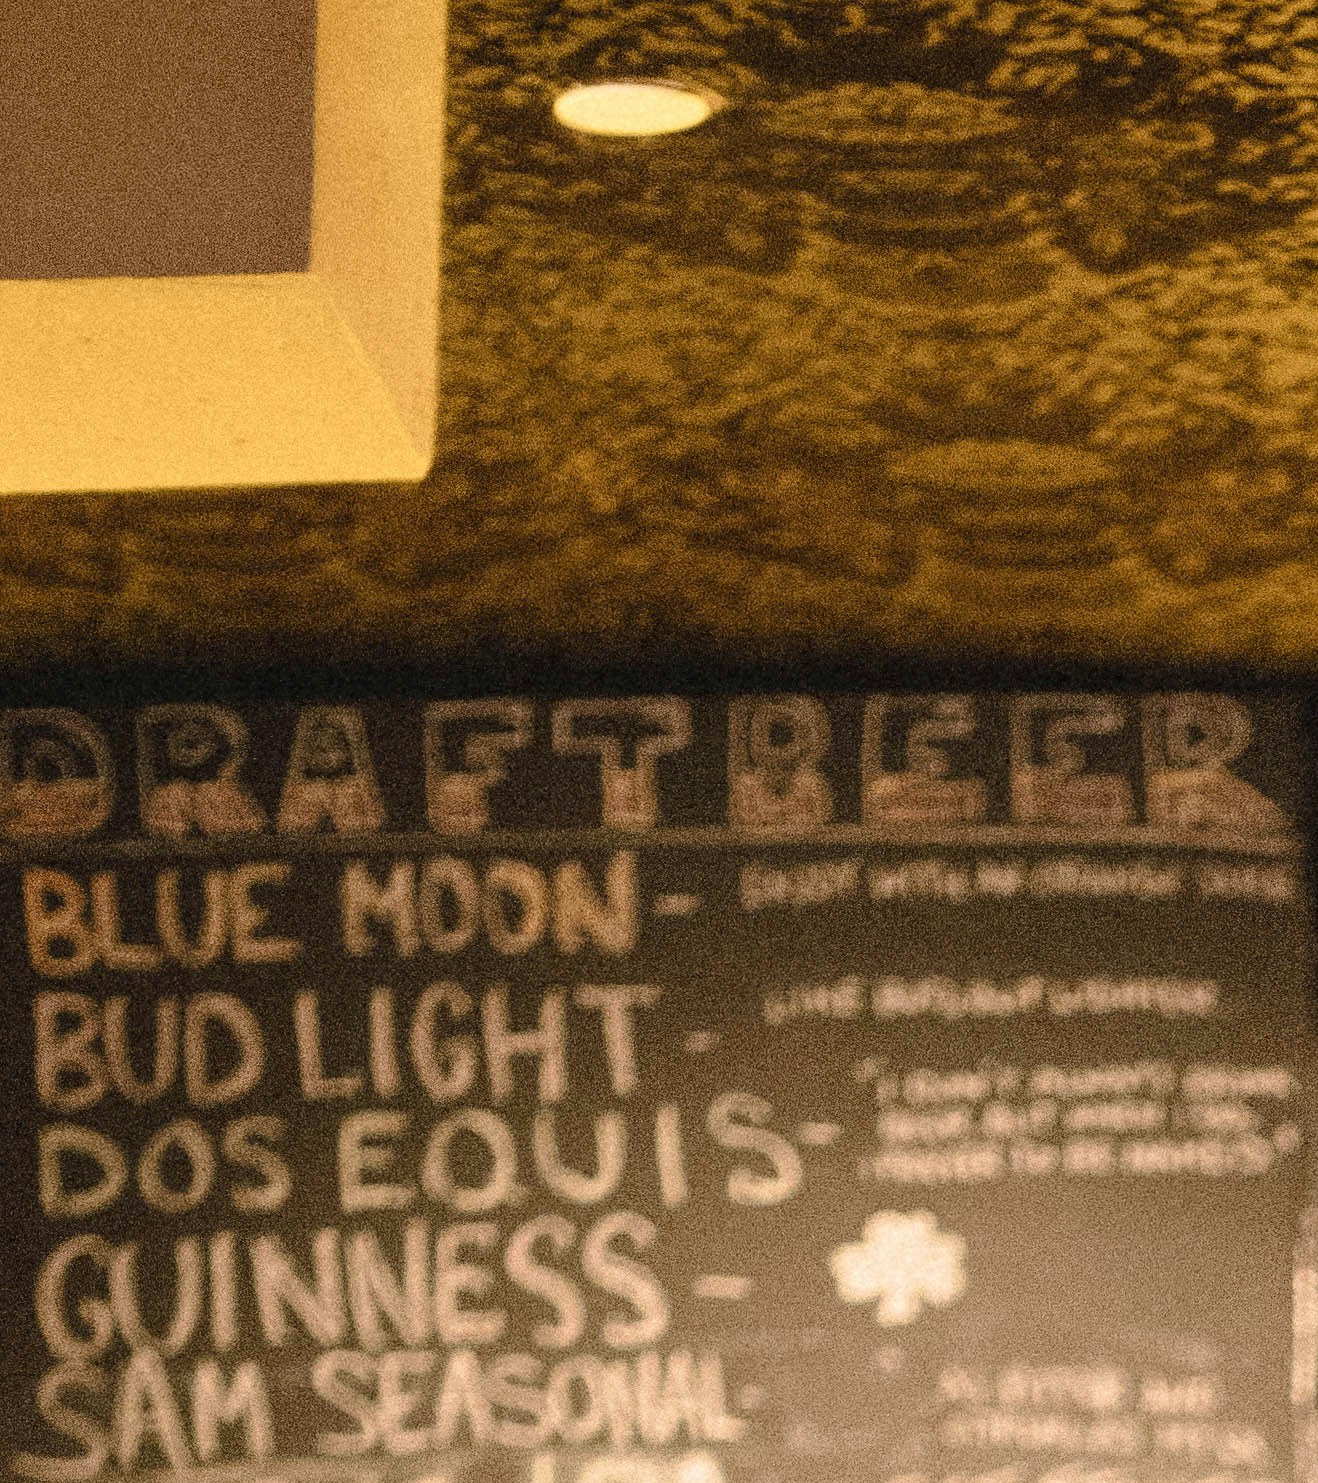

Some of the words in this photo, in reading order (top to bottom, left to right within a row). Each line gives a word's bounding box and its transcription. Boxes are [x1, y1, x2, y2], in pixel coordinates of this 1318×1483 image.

[2, 694, 692, 836] DRAFT
[728, 693, 1296, 840] BEER
[23, 862, 298, 977] BLUE
[339, 850, 638, 959] MOON
[34, 991, 266, 1110] BUD
[295, 981, 660, 1102] LIGHT
[38, 1113, 294, 1217] DOS
[337, 1092, 801, 1213] EQUIS
[35, 1211, 669, 1363] GUINNESS
[9, 1346, 275, 1481] SAM
